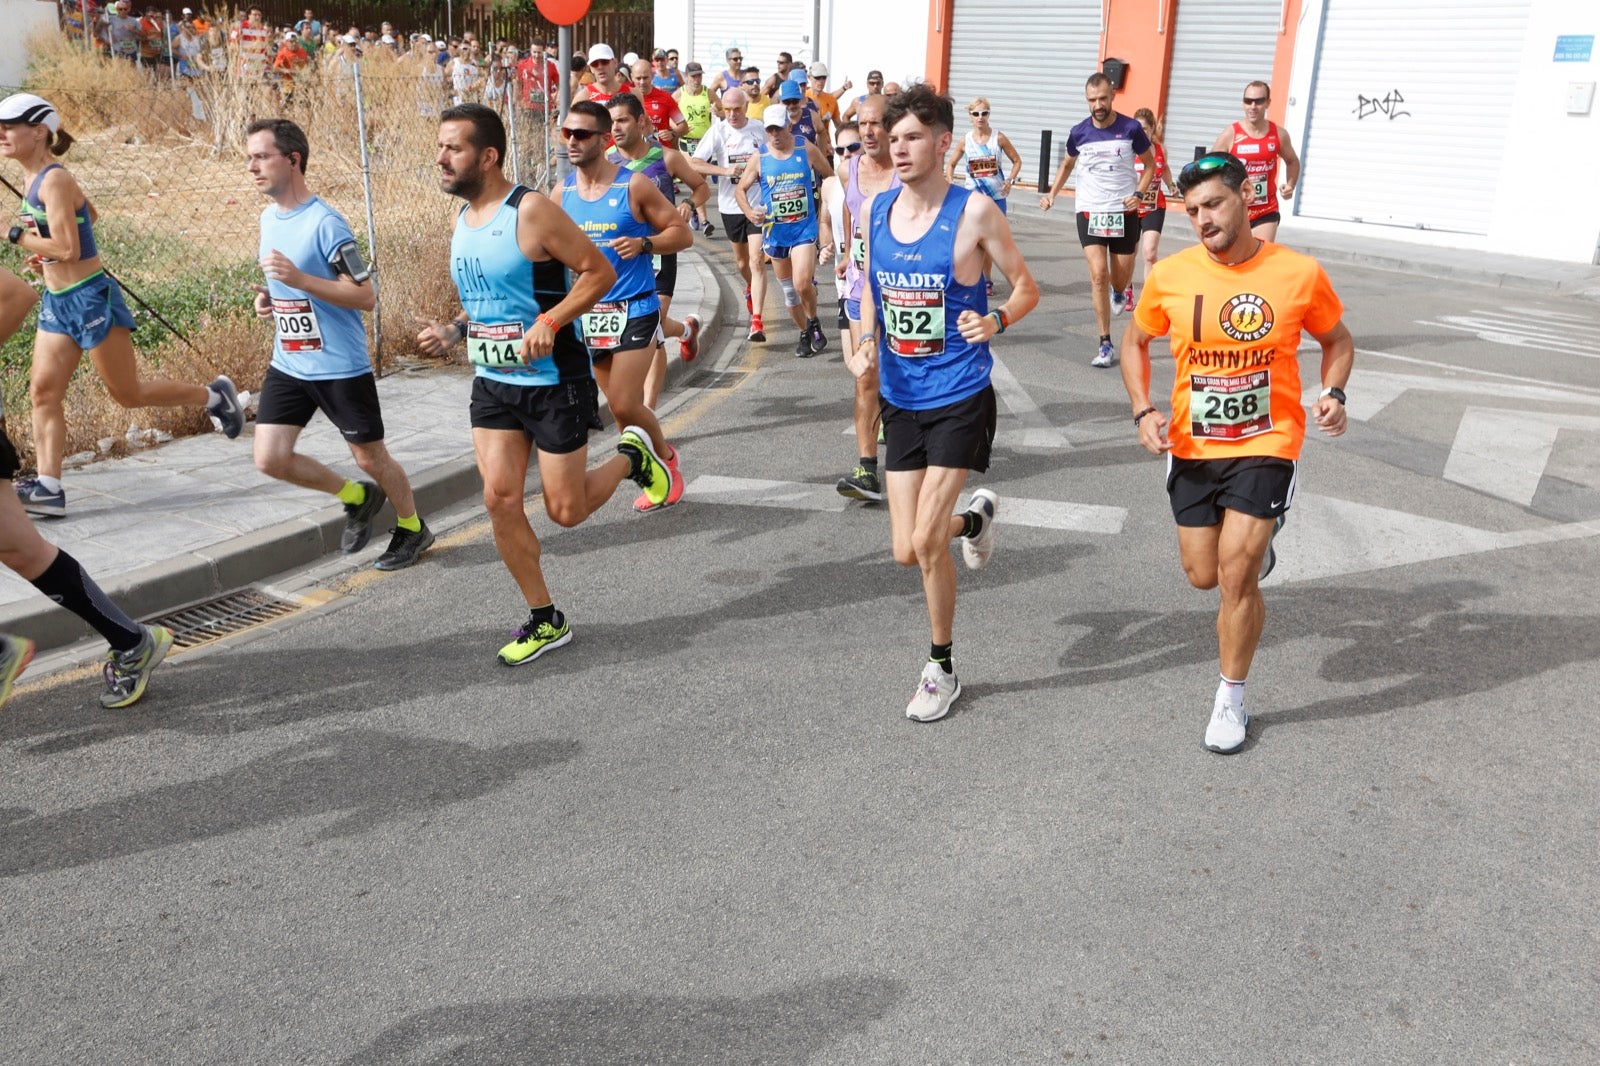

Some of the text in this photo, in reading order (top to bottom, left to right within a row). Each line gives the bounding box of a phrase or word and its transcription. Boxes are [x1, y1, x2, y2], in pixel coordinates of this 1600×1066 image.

[973, 162, 997, 171] 2162
[1144, 192, 1157, 201] 29
[779, 199, 803, 214] 529
[1092, 215, 1123, 227] 1034
[876, 271, 946, 288] GUADIX
[923, 291, 938, 300] FONDO
[1230, 294, 1264, 307] BEER
[589, 315, 620, 333] 526
[890, 309, 932, 335] 952
[1222, 321, 1272, 341] RUNNERS
[478, 342, 518, 364] 114
[1188, 347, 1275, 368] RUNNING
[1204, 394, 1258, 420] 268
